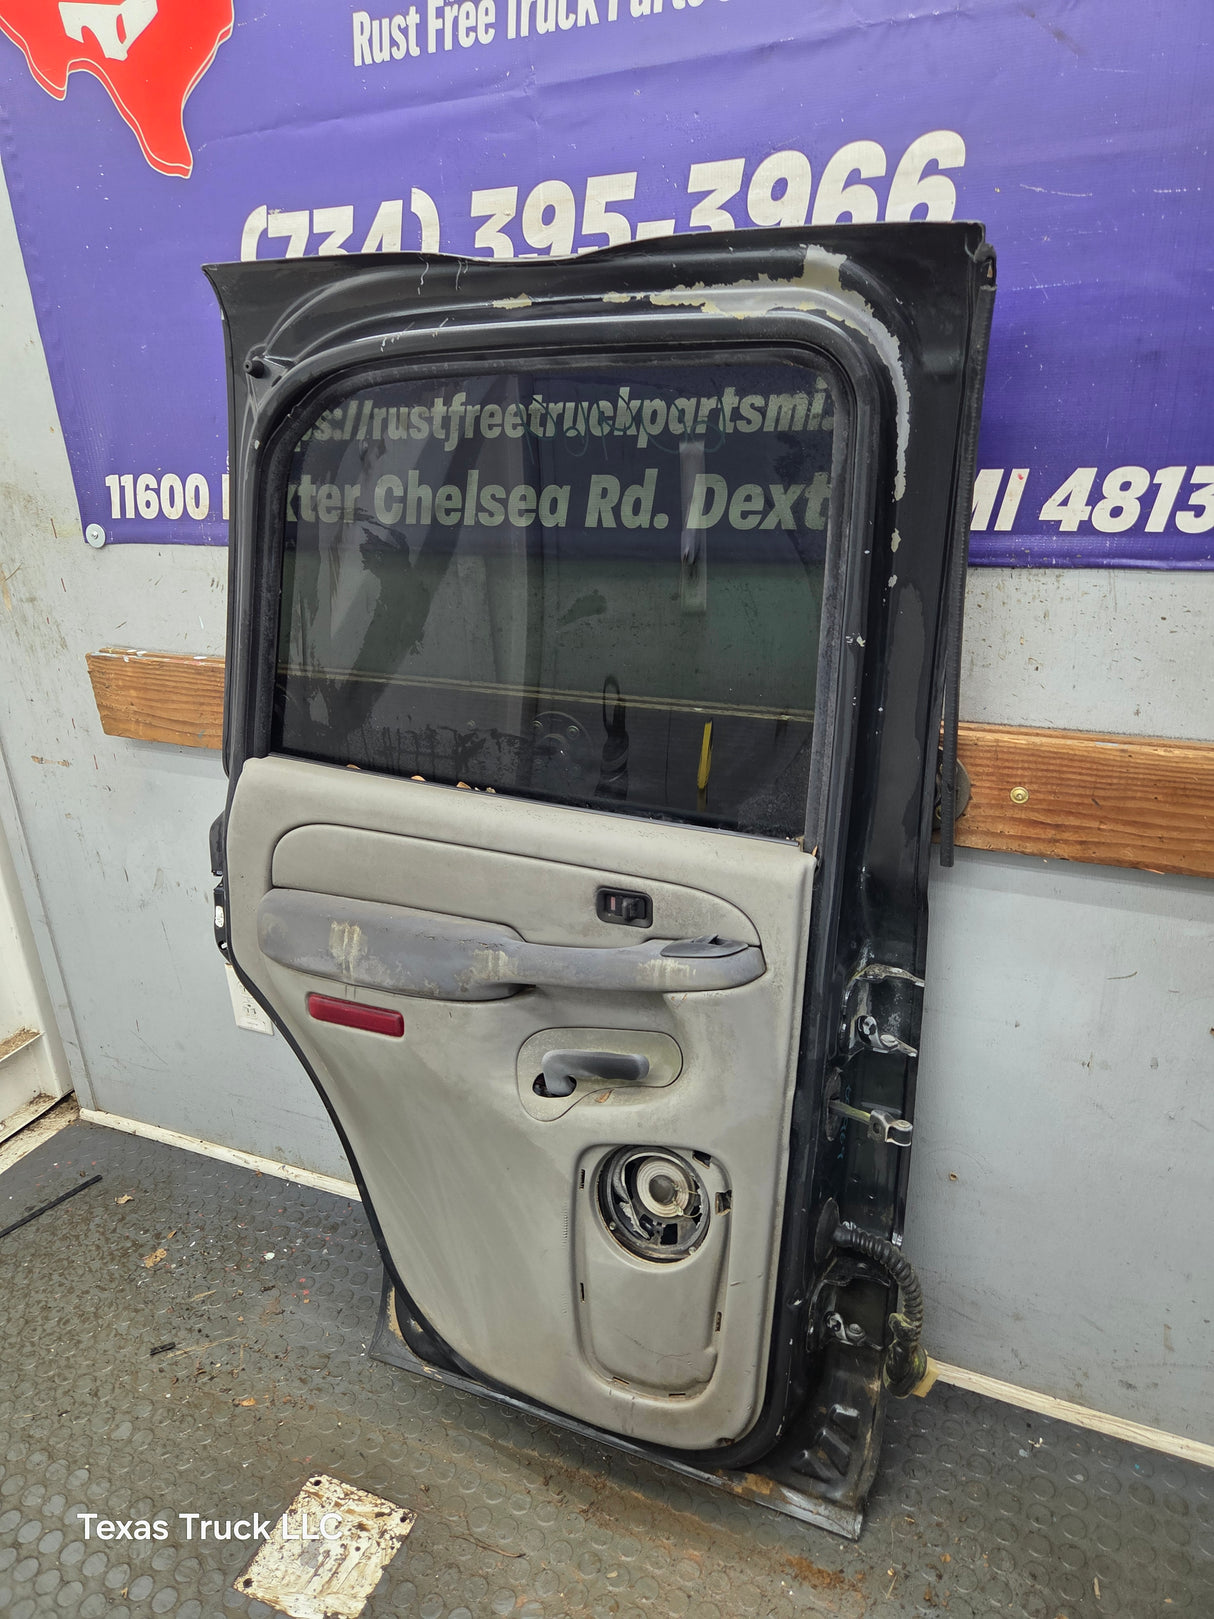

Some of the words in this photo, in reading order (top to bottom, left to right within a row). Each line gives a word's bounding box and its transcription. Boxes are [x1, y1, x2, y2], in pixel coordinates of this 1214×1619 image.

[352, 5, 421, 67] Rust
[427, 0, 496, 54] Free
[240, 187, 441, 262] (734)
[471, 129, 966, 259] 395-3966
[104, 473, 210, 520] 11600
[374, 470, 571, 527] Chelsea
[585, 468, 670, 529] Rd.
[1038, 466, 1214, 534] 4813
